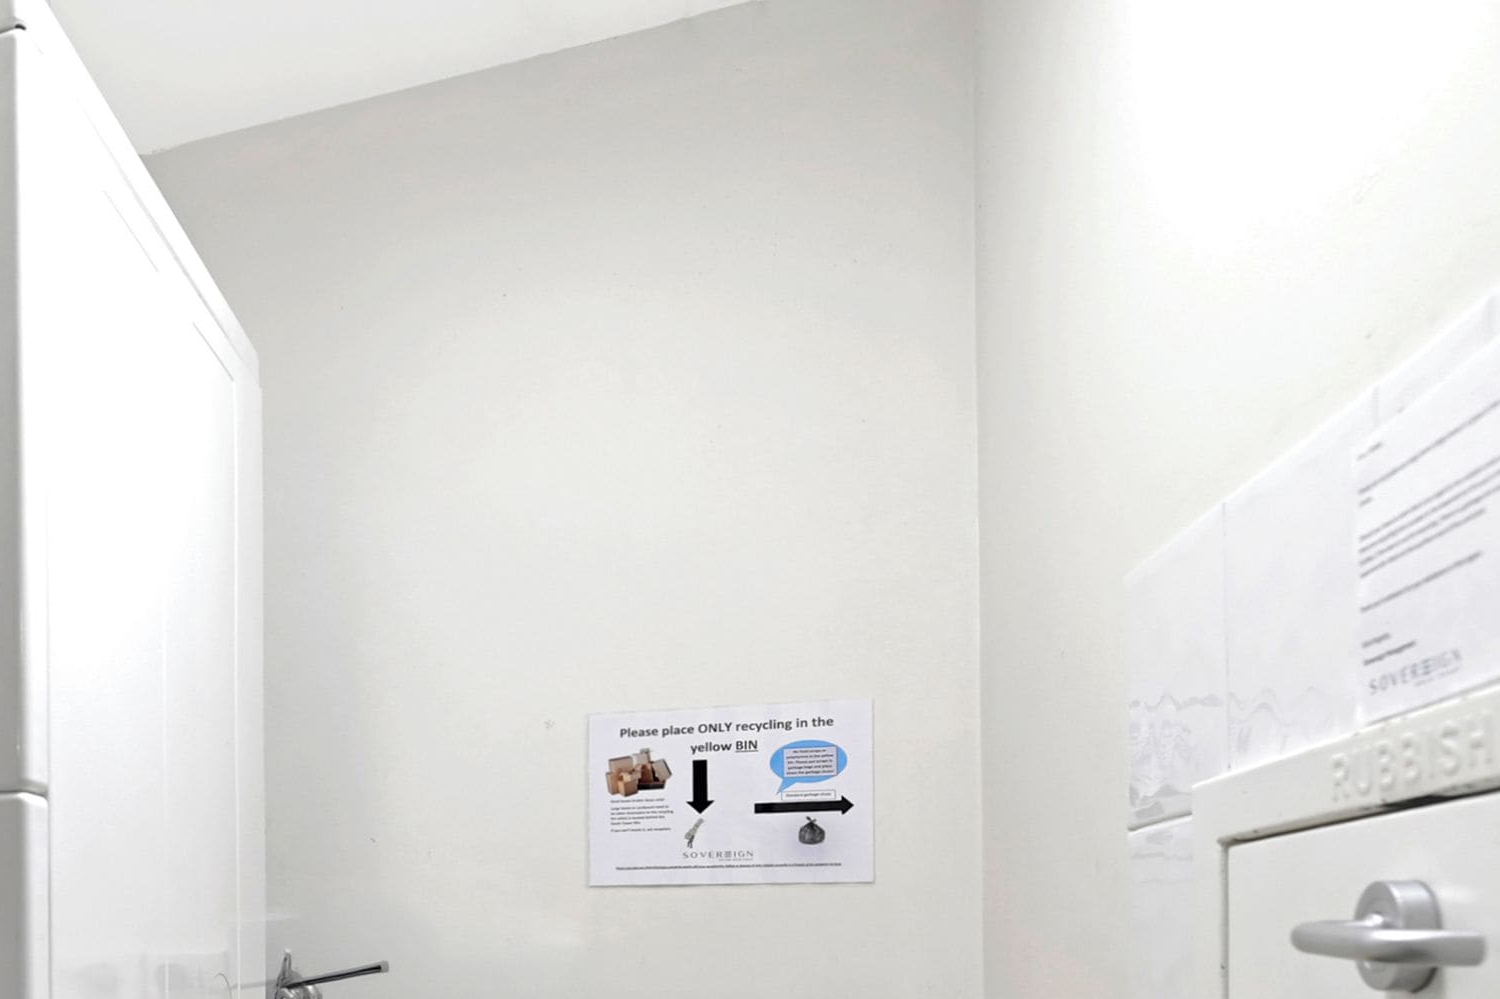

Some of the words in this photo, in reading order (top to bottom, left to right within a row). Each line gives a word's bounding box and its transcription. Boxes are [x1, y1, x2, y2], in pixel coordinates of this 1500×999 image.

[620, 726, 658, 738] Please
[662, 725, 694, 739] place
[698, 722, 732, 735] ONLY
[735, 719, 792, 734] recycling
[796, 717, 808, 728] in
[812, 717, 834, 727] the
[691, 742, 732, 755] yellow
[735, 740, 758, 752] BIN
[1331, 709, 1493, 802] RUBBISH
